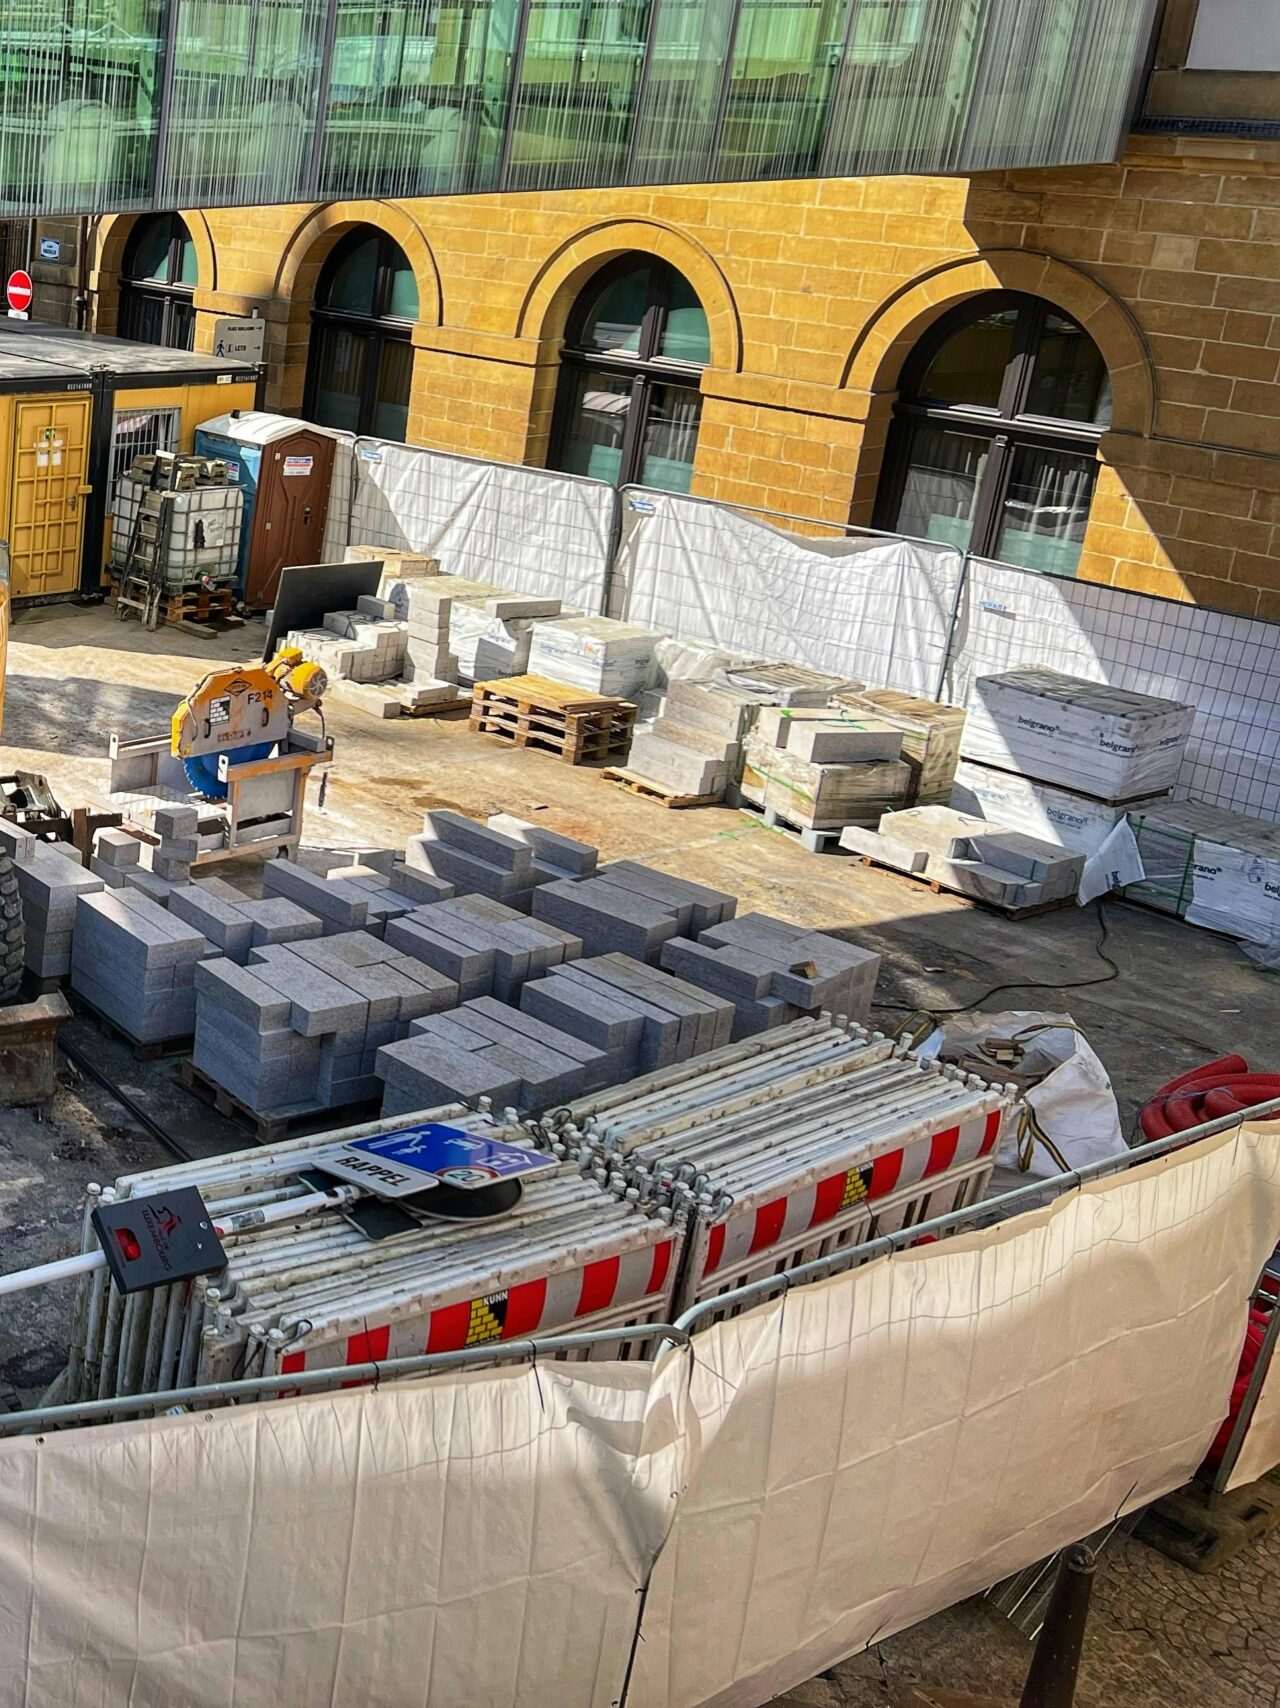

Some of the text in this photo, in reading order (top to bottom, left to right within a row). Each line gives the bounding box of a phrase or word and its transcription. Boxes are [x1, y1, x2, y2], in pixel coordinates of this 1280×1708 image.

[333, 1156, 412, 1187] RAPPEL
[447, 1170, 485, 1182] 20
[141, 1209, 172, 1271] LUXEMBOURG
[483, 1290, 509, 1306] KUHN
